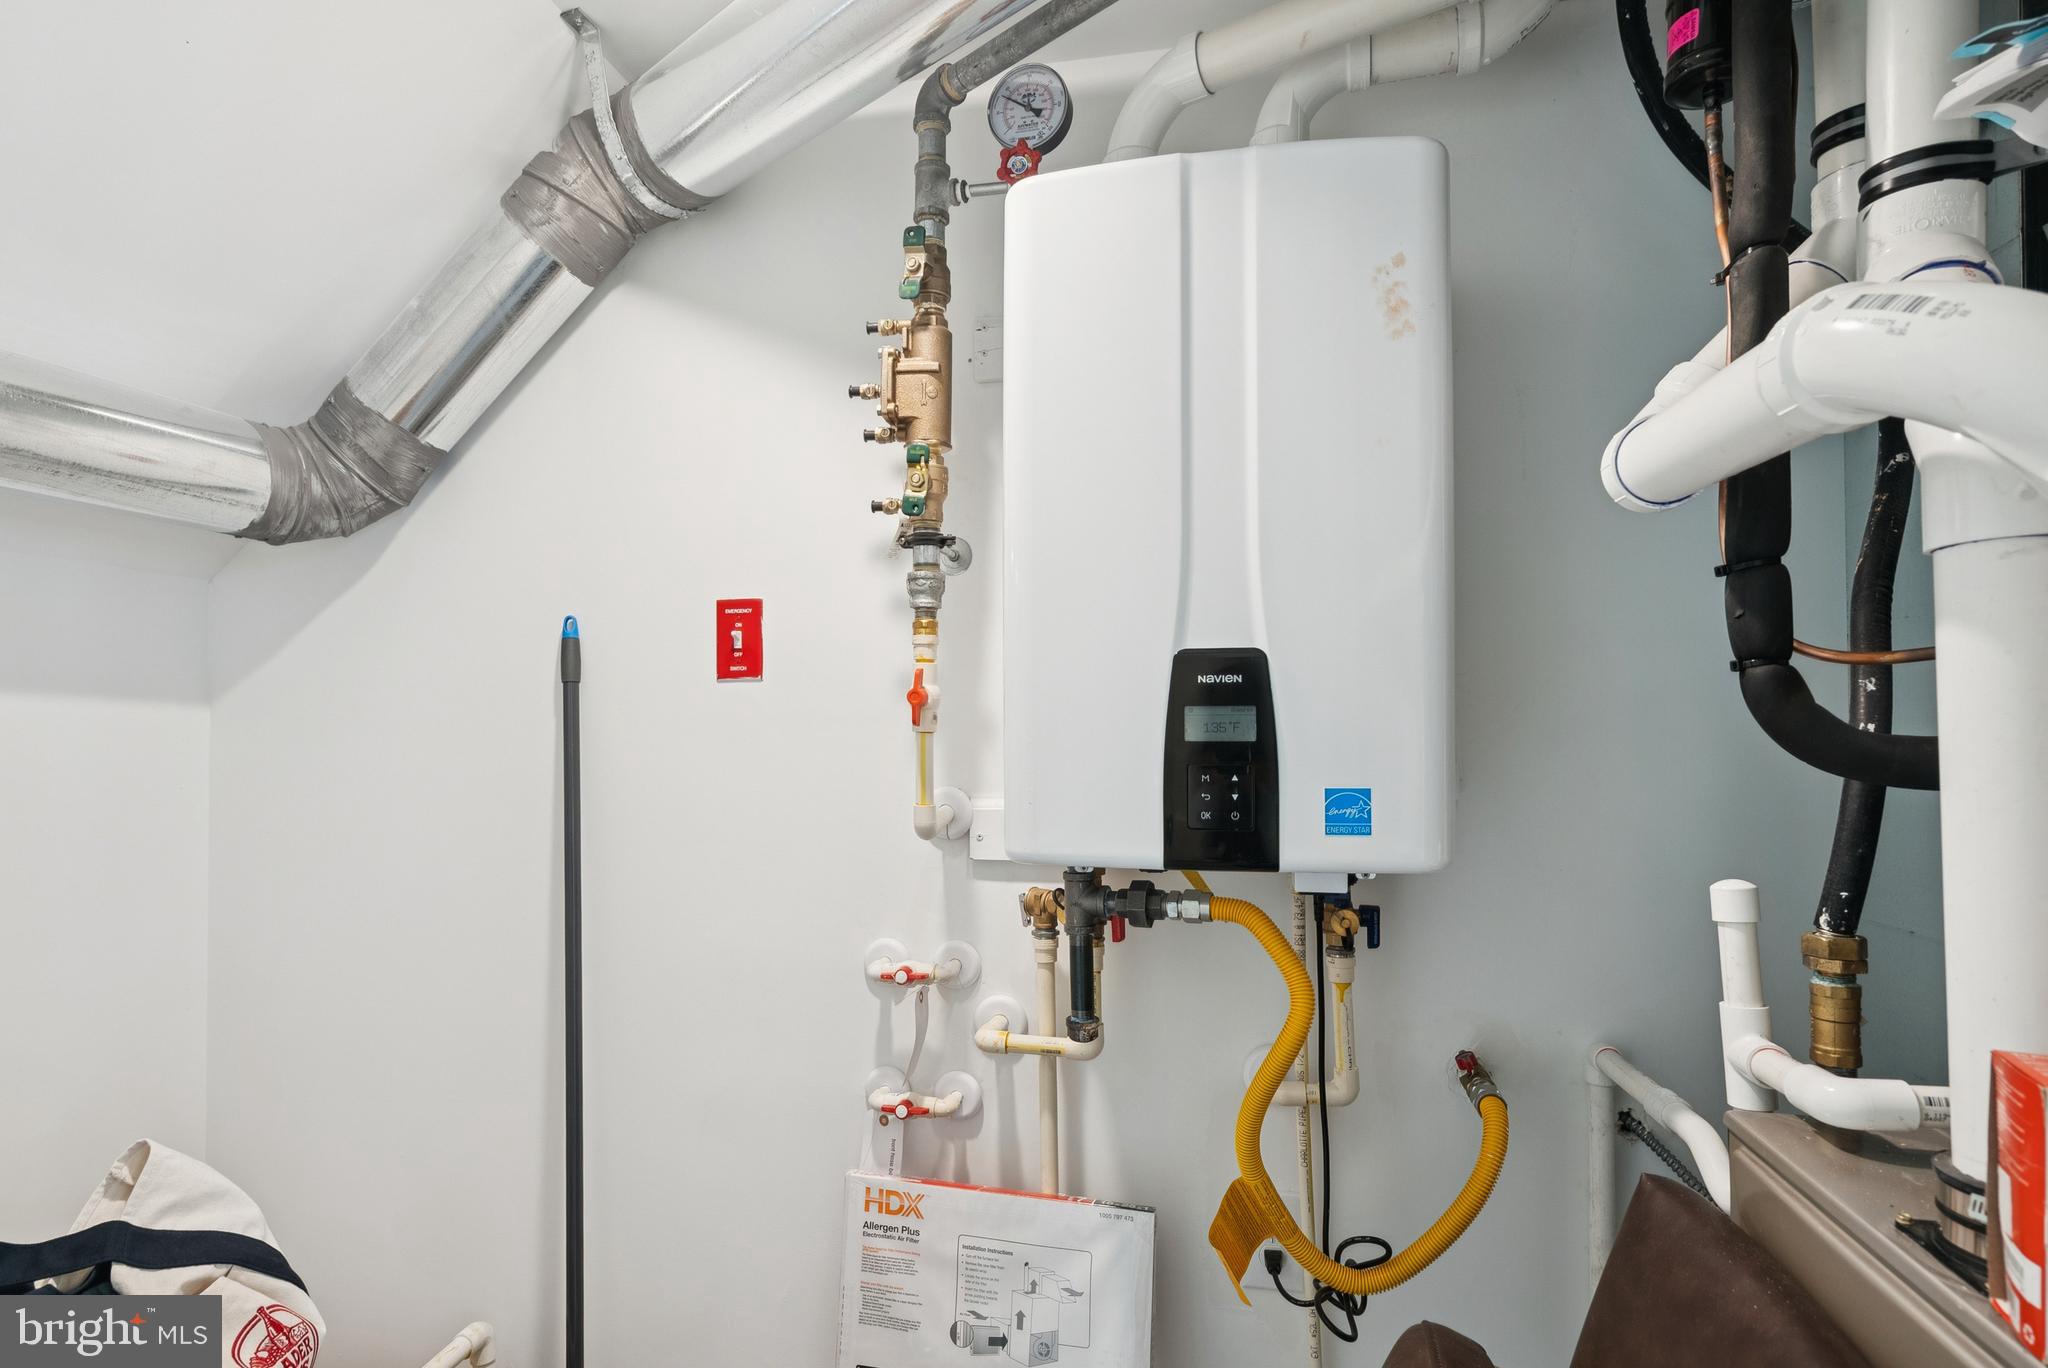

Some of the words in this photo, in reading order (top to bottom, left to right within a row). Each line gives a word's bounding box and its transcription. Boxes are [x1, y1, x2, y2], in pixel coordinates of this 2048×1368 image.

[1201, 774, 1210, 782] M
[1200, 811, 1211, 820] OK
[1326, 826, 1353, 834] ENERGY
[1353, 826, 1371, 834] STAR
[1298, 1130, 1309, 1168] CHARLOTTE
[864, 1187, 925, 1220] HDX
[863, 1221, 899, 1233] Allergen
[901, 1225, 921, 1237] Plus
[862, 1231, 897, 1241] Electrostatic
[961, 1244, 987, 1253] Installation
[987, 1248, 1014, 1256] Instructions
[281, 1335, 313, 1368] ADER
